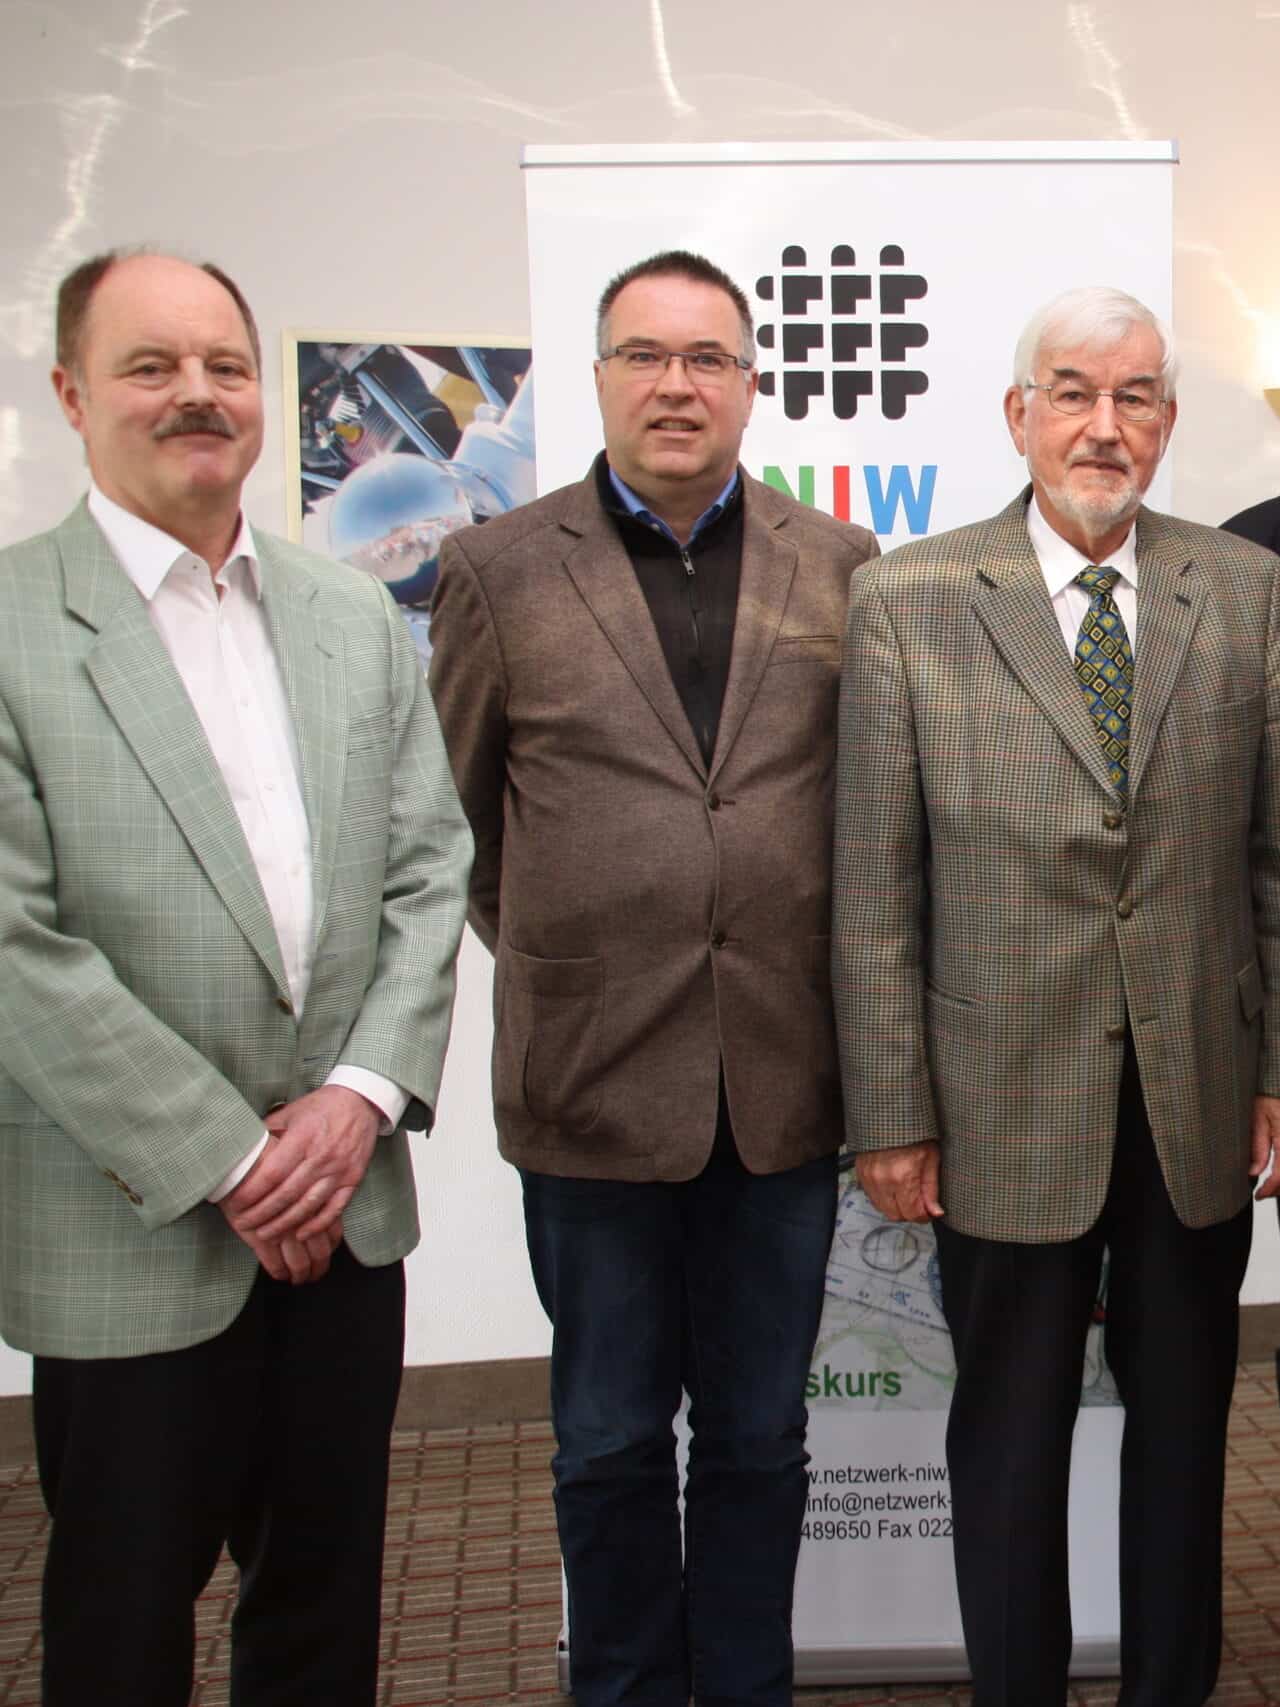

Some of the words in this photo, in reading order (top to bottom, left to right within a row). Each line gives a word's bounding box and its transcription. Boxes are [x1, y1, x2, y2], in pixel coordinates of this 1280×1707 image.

[805, 1364, 902, 1398] skurs
[801, 1520, 871, 1540] 489650
[878, 1519, 912, 1539] Fax
[918, 1517, 953, 1537] 022
